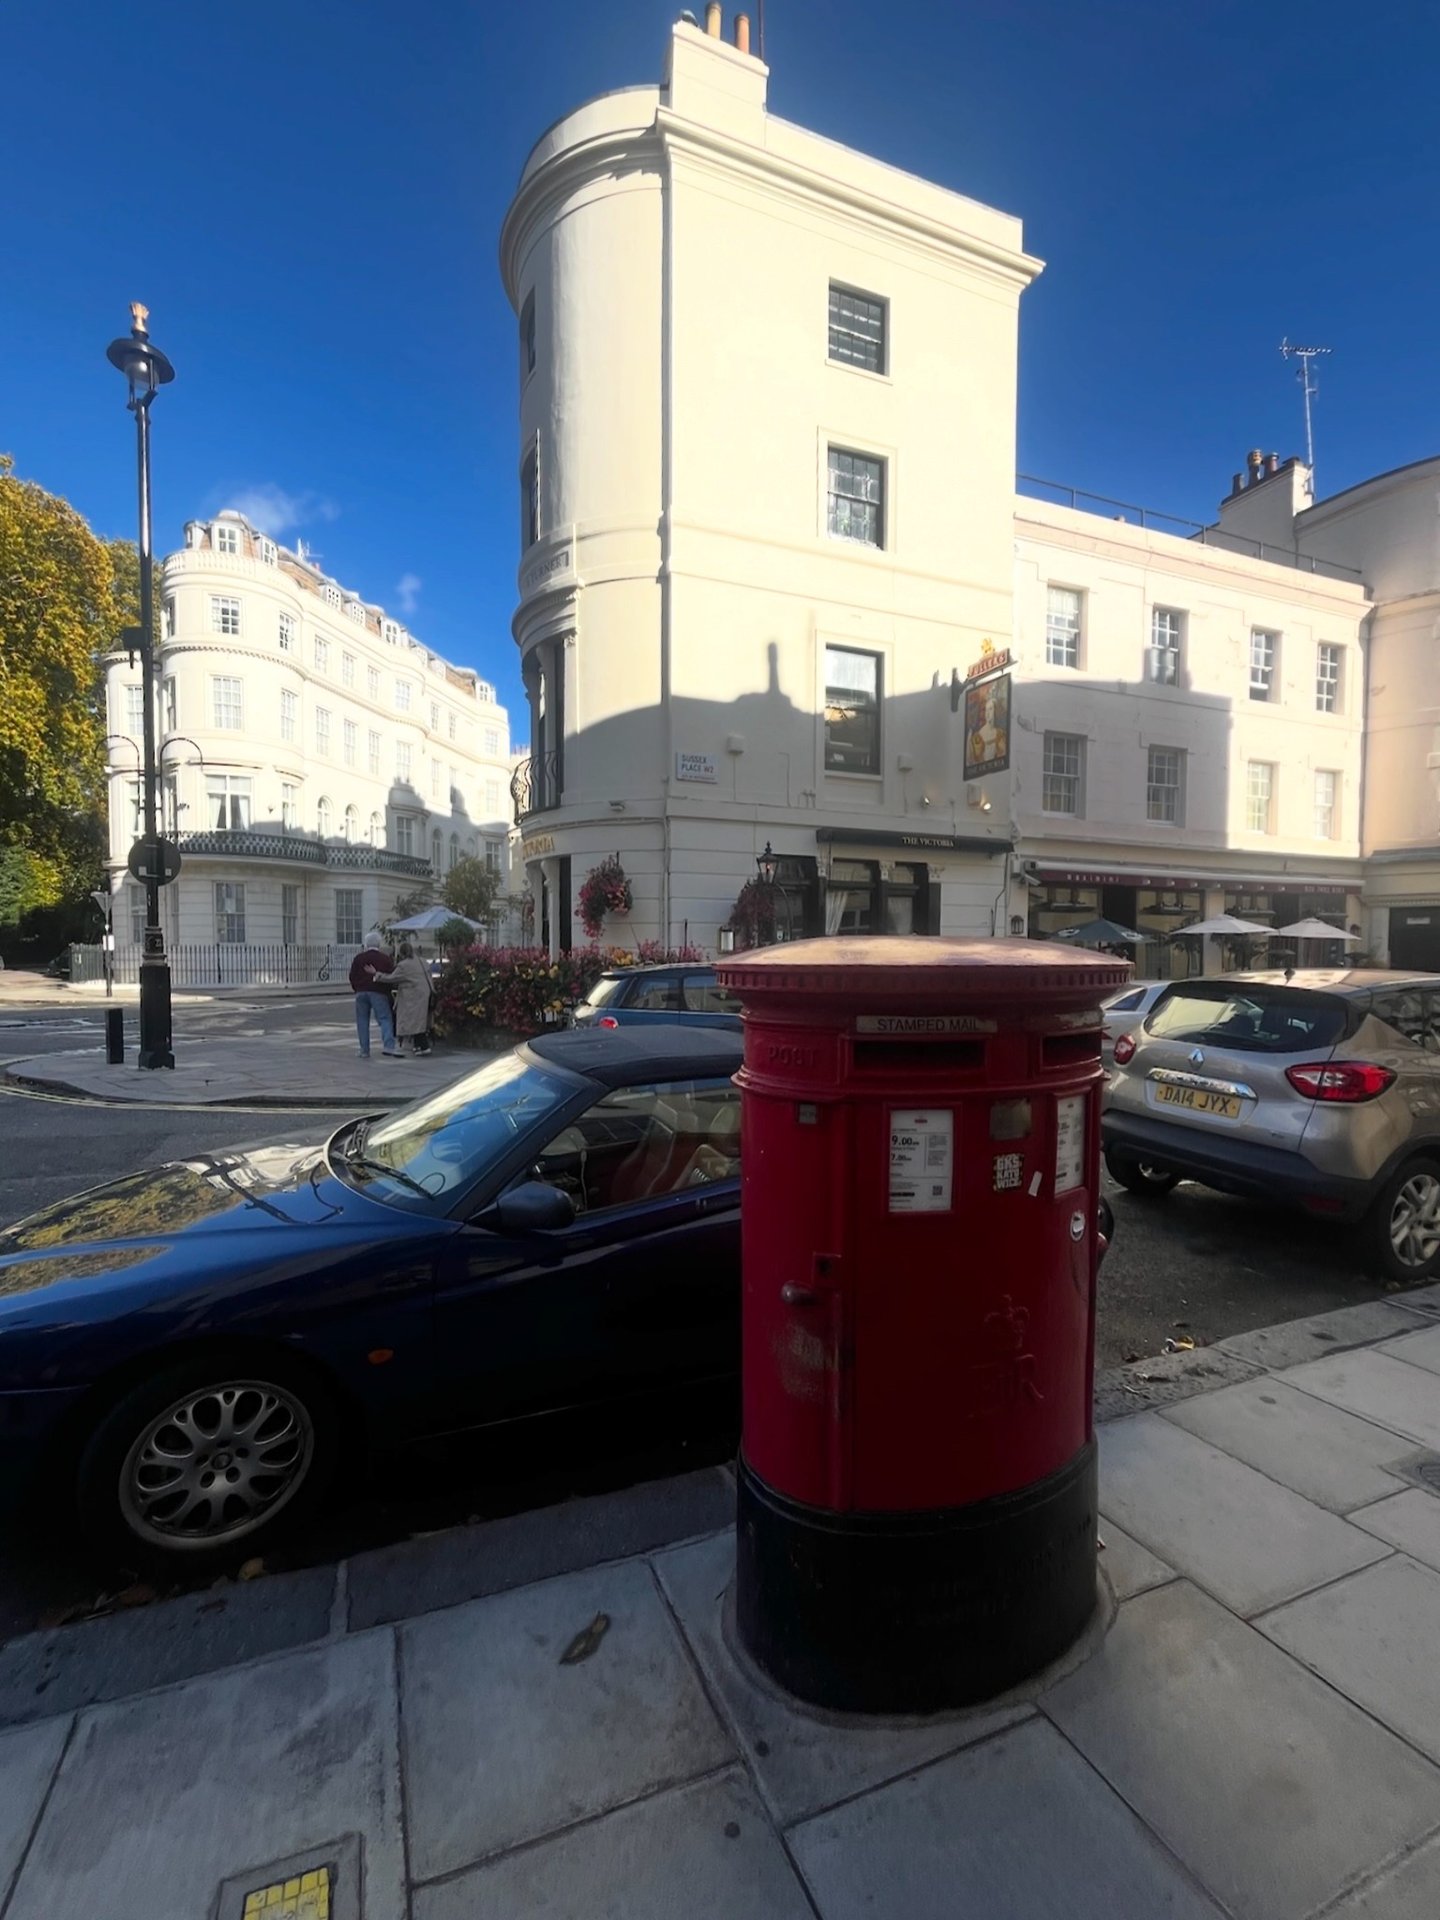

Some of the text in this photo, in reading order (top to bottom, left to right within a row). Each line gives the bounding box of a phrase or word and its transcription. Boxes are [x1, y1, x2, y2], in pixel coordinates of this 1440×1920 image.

[682, 754, 707, 764] SUSSEX
[681, 763, 714, 774] PLACE W2
[902, 836, 954, 848] THE VICTORIA
[877, 1018, 981, 1032] STAMPED MAIL
[768, 1045, 817, 1067] POST
[1163, 1086, 1231, 1113] DA14 JYX
